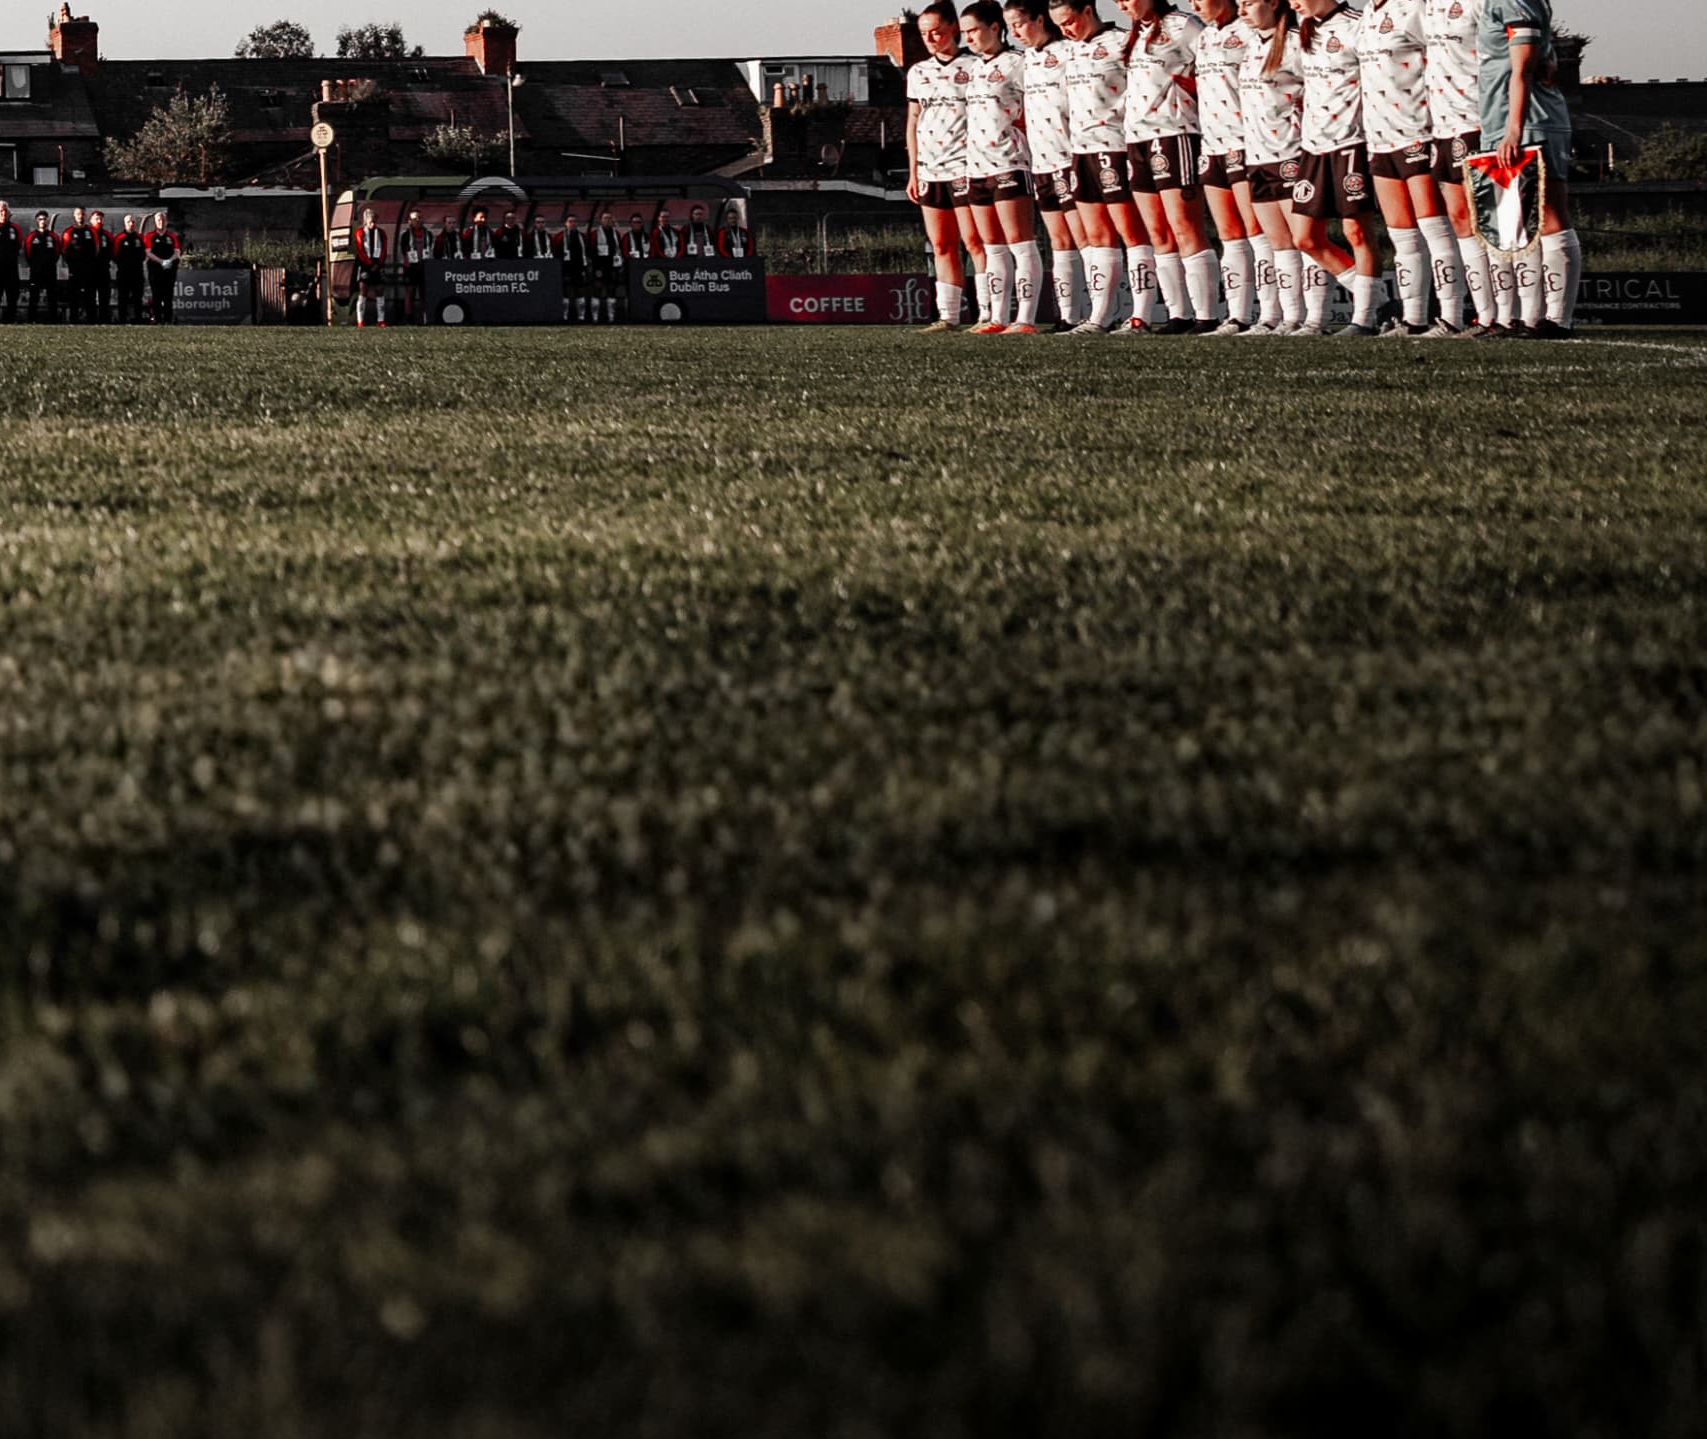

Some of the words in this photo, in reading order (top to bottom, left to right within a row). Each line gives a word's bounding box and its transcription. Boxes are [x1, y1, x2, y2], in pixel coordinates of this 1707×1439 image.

[1150, 139, 1162, 154] 4
[1098, 153, 1111, 168] 5
[1340, 149, 1355, 174] 7
[444, 271, 476, 281] Proud
[478, 271, 525, 281] Partners
[527, 270, 539, 281] Of
[669, 270, 691, 281] Bus
[720, 270, 752, 281] Cliath
[173, 281, 195, 297] ile
[198, 280, 238, 296] Thai
[455, 283, 508, 294] Bohemian
[669, 282, 705, 292] Dublin
[708, 282, 730, 292] Bus
[1578, 278, 1681, 300] TRICAL
[171, 298, 230, 312] sborough
[788, 296, 865, 313] COFFEE
